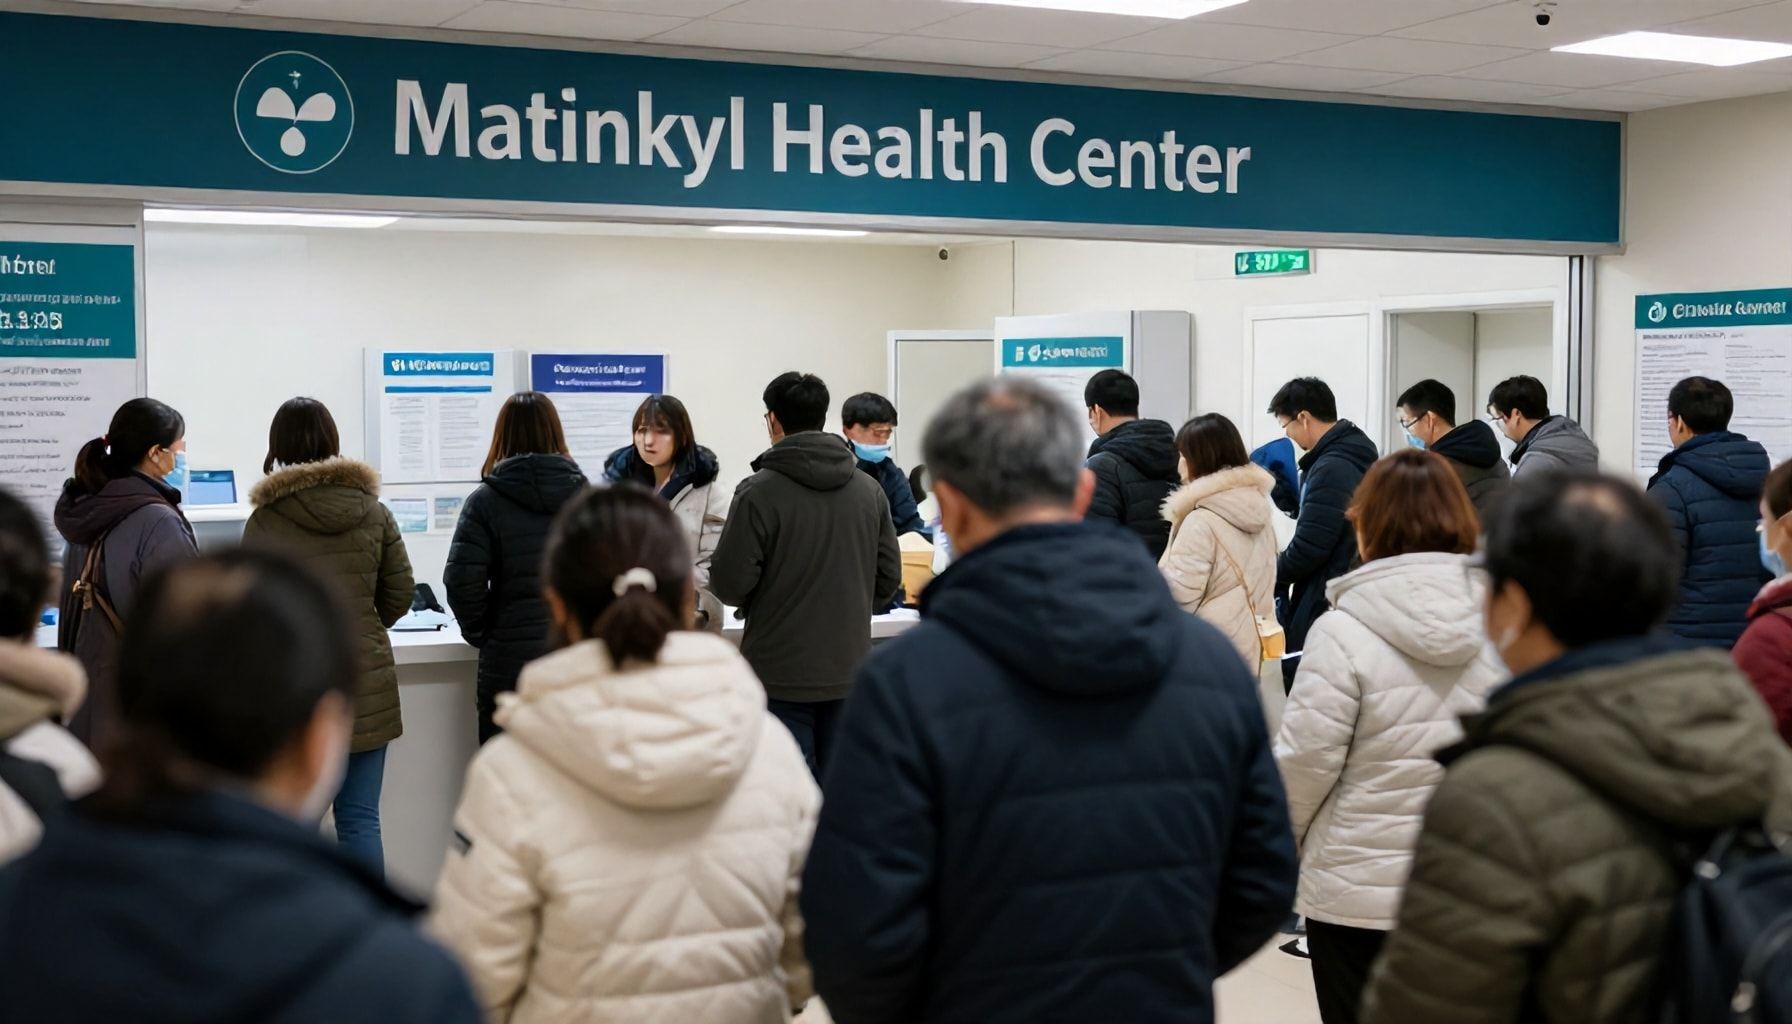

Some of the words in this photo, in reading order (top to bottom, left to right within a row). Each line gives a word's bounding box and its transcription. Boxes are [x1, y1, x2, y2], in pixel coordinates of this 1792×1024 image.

[393, 79, 744, 189] Matinkyl
[773, 103, 1008, 184] Health
[1030, 118, 1252, 195] Center
